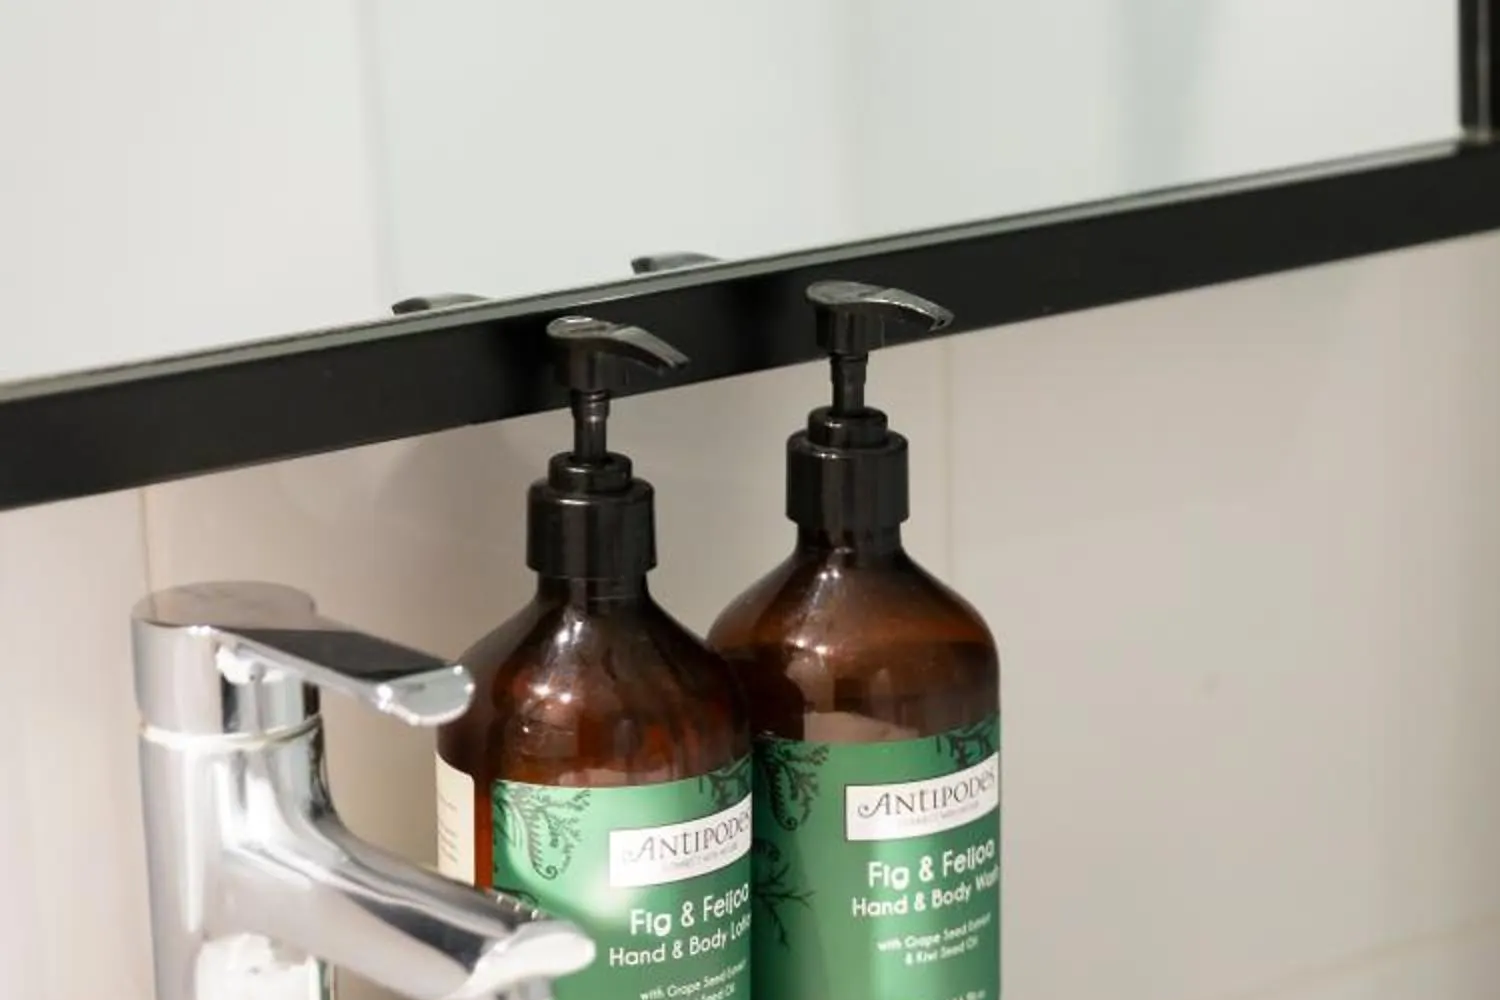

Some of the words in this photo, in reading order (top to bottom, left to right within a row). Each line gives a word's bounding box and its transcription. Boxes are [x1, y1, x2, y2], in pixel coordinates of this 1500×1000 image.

[868, 861, 910, 890] Fig
[918, 855, 934, 882] &
[943, 839, 995, 878] Feijoa
[630, 908, 673, 937] Fig
[681, 901, 695, 928] &
[703, 883, 749, 922] Feijoa
[852, 894, 908, 917] Hand
[913, 891, 926, 912] &
[931, 882, 972, 909] Body
[609, 943, 666, 968] Hand
[671, 940, 684, 959] &
[689, 928, 727, 955] Body
